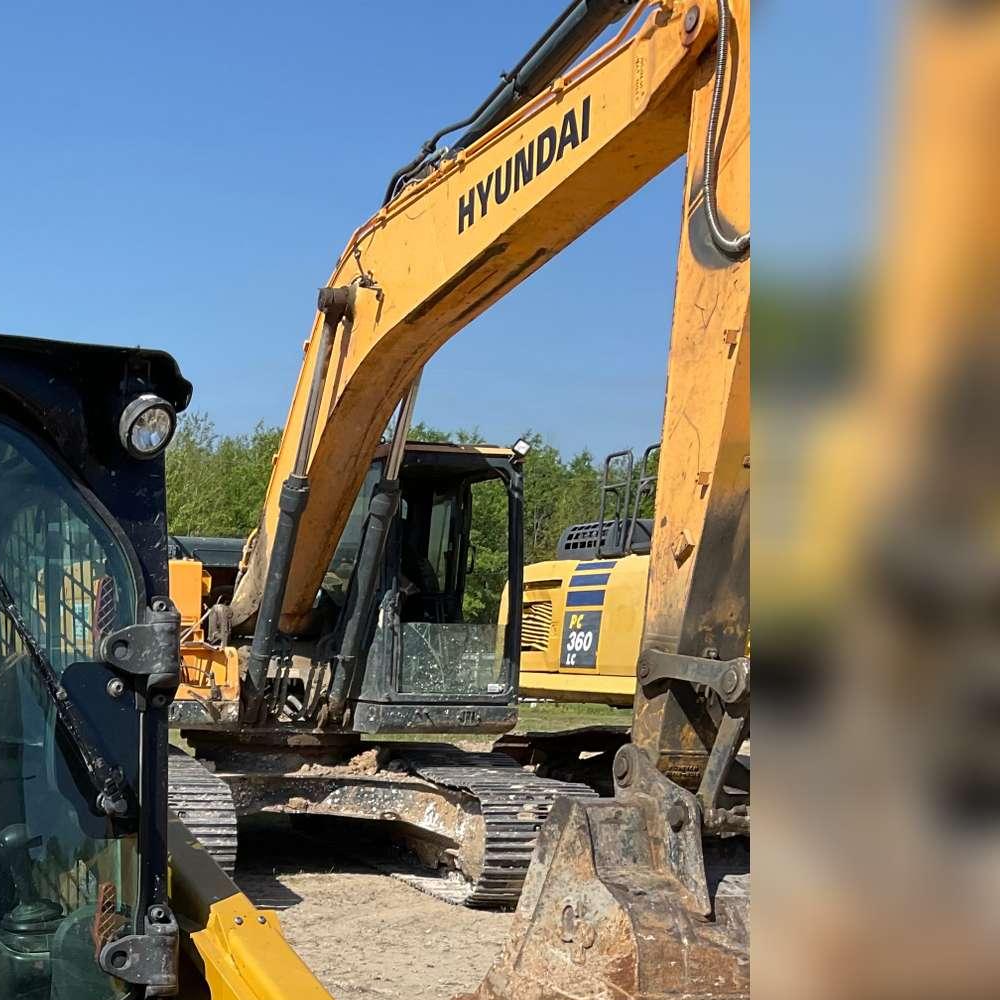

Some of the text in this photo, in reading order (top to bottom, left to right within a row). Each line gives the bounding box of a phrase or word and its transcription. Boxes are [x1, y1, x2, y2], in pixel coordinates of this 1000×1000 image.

[457, 95, 591, 235] HYUNDAI
[569, 614, 584, 629] PC
[566, 631, 593, 651] 360
[565, 653, 577, 666] LC
